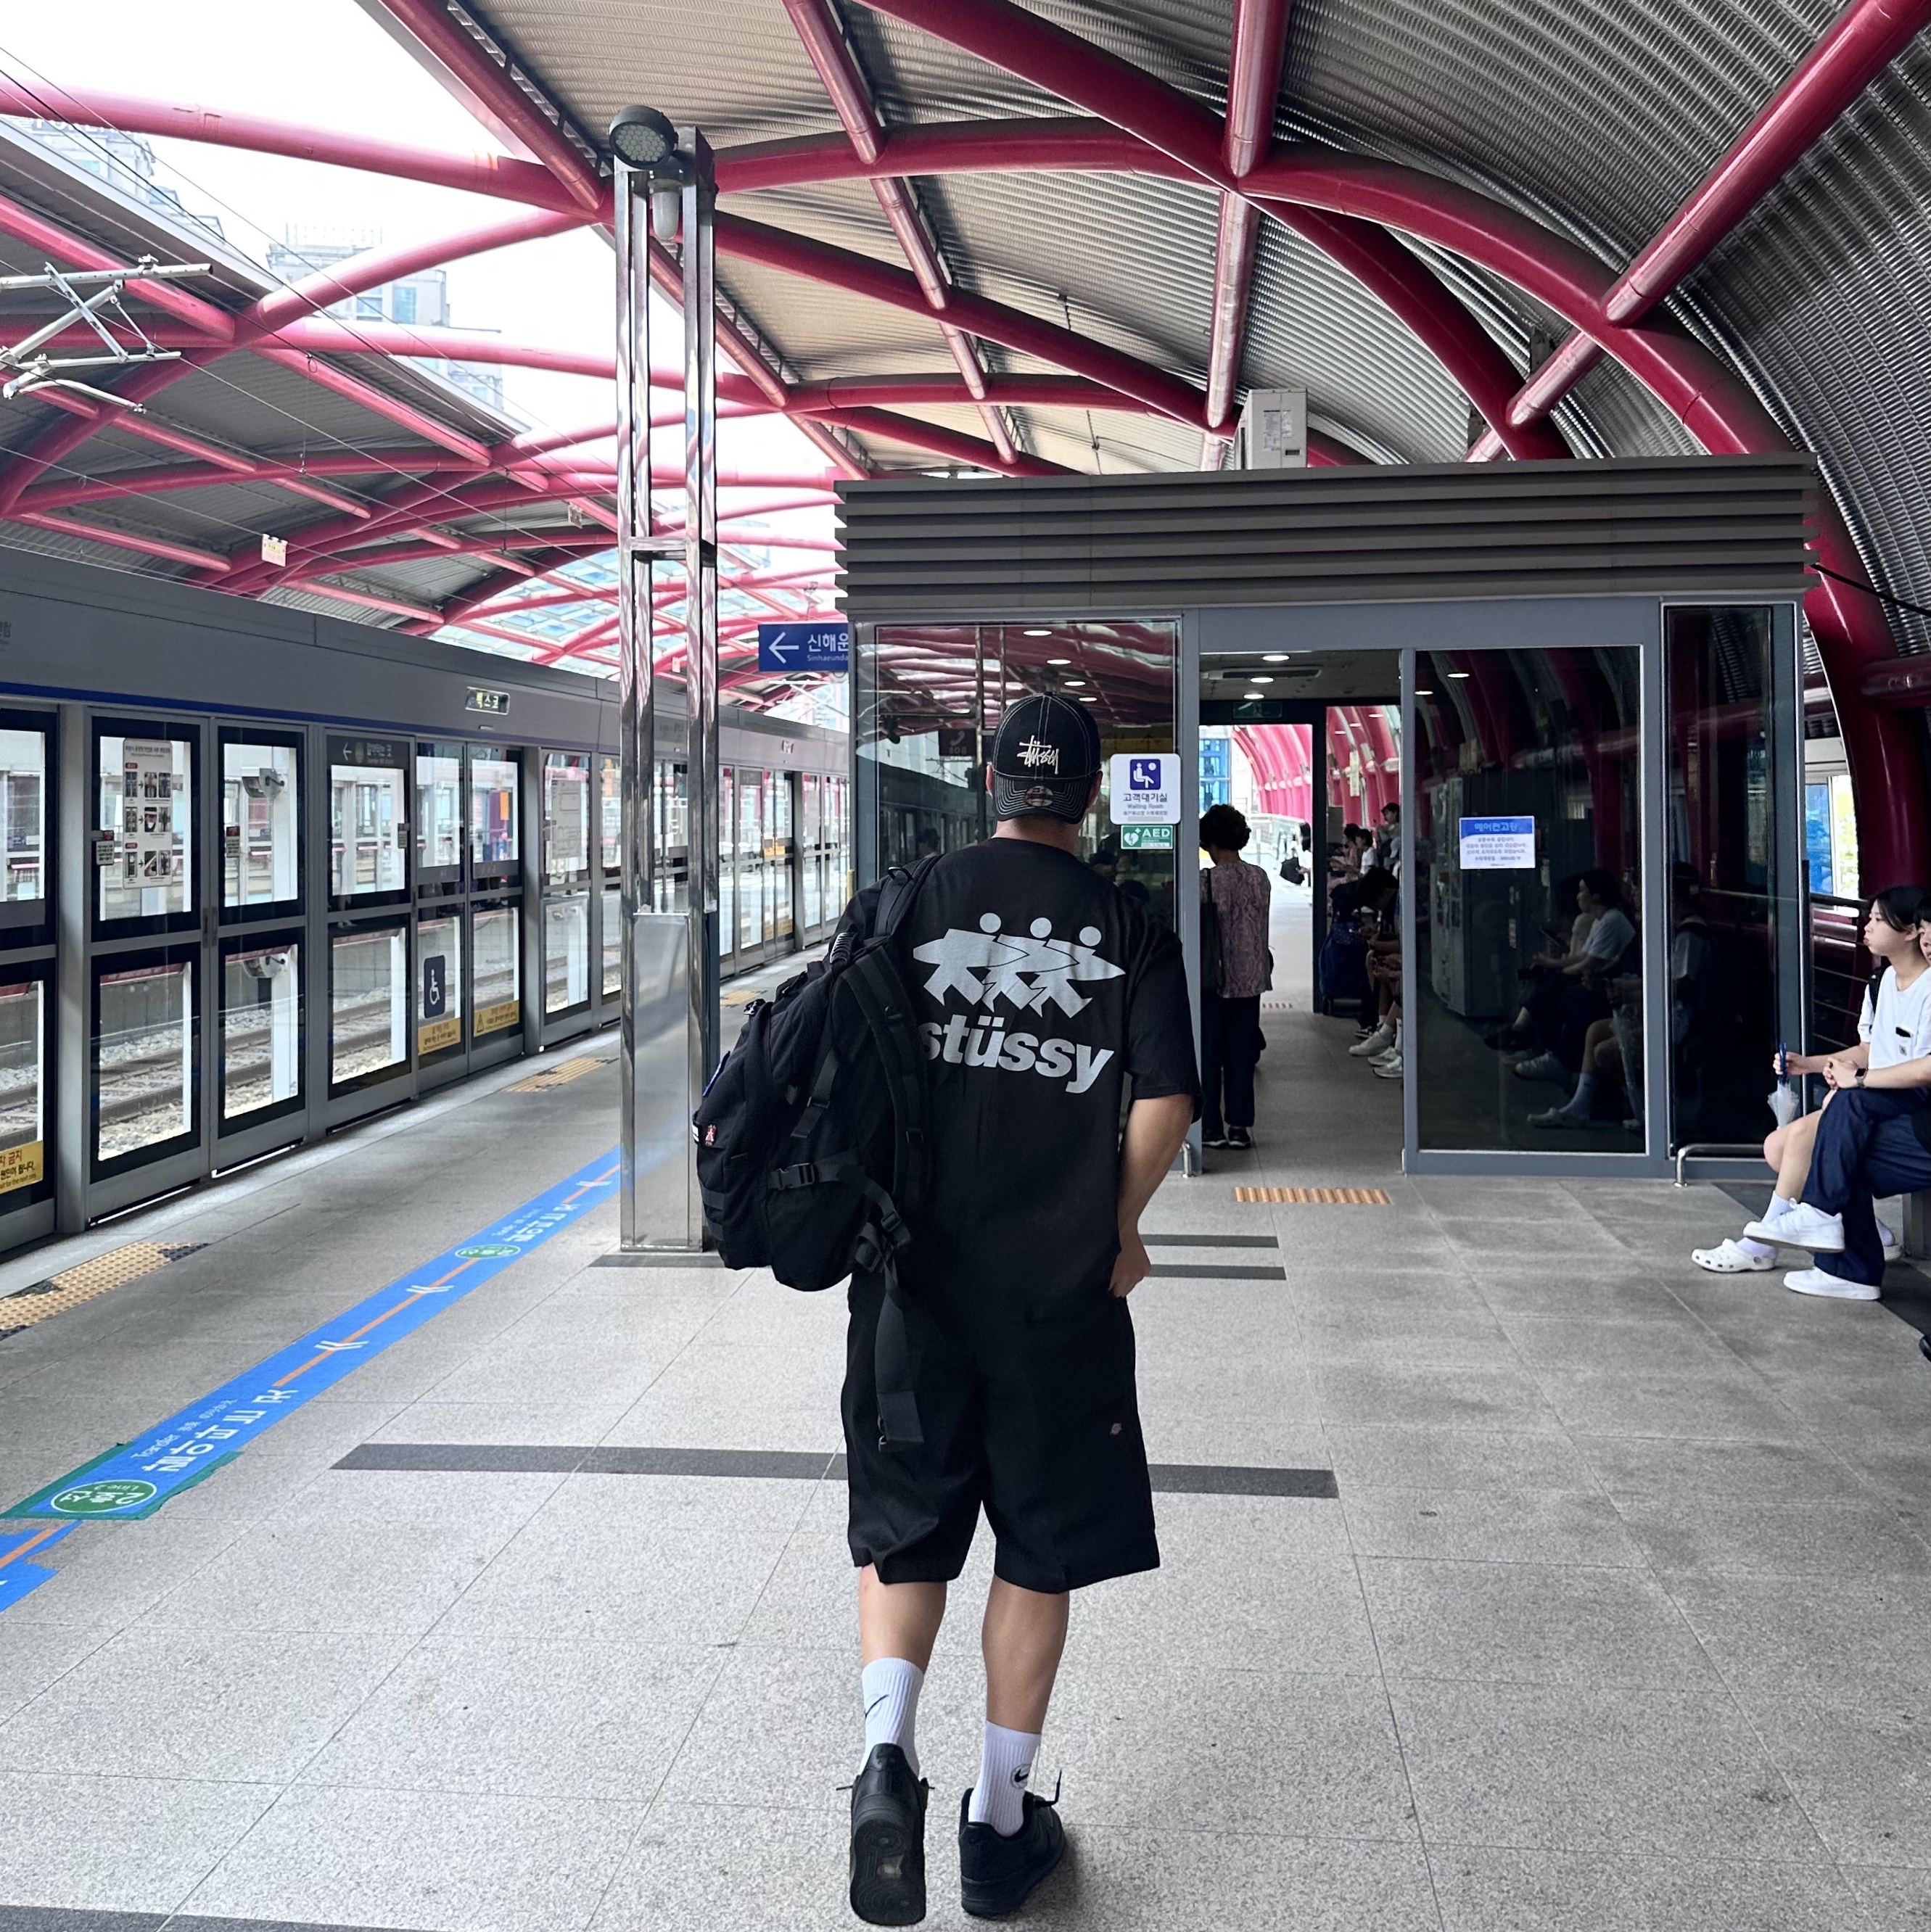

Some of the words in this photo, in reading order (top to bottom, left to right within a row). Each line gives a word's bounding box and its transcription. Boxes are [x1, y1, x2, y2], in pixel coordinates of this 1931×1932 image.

[1123, 793, 1168, 803] 고객대기실
[1142, 828, 1171, 838] AED
[918, 1014, 1115, 1094] stüssy
[8, 1149, 22, 1165] 금지
[141, 1410, 267, 1471] 갈아타는
[251, 1389, 299, 1403] 곳
[59, 1490, 145, 1505] 2호선
